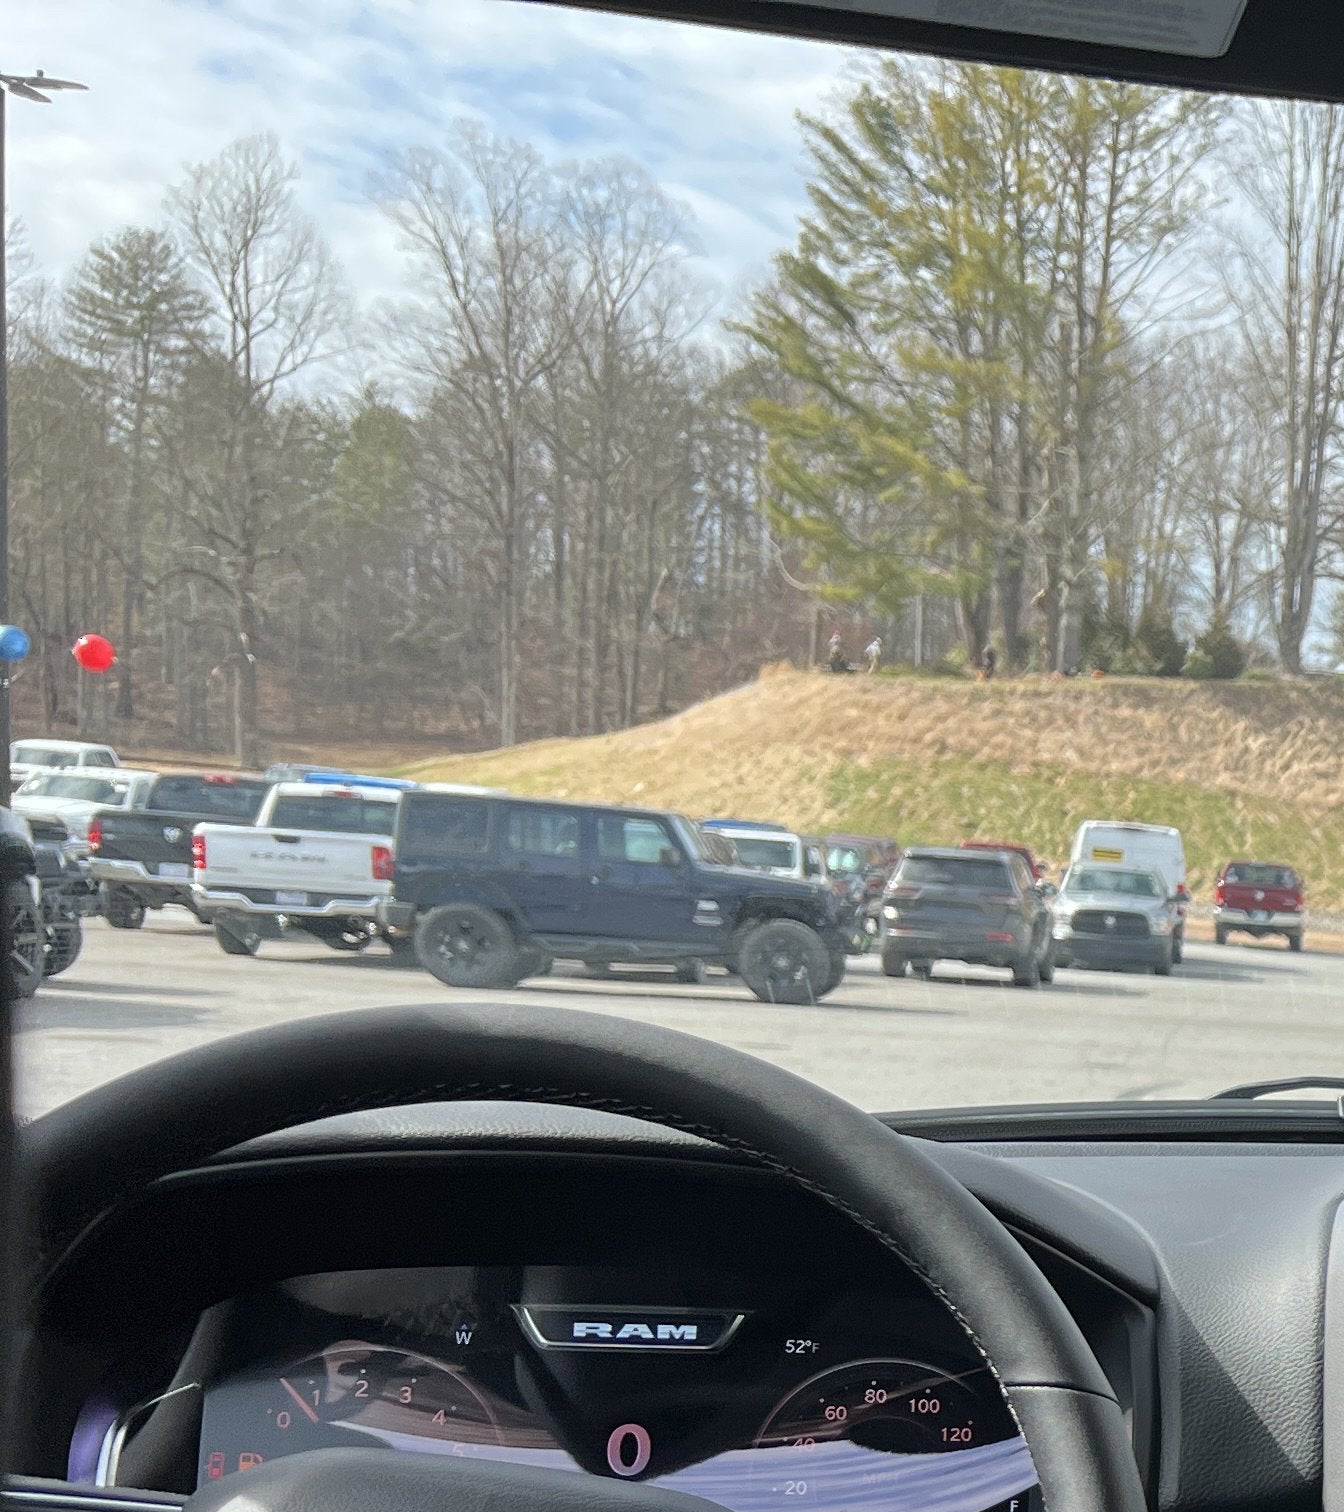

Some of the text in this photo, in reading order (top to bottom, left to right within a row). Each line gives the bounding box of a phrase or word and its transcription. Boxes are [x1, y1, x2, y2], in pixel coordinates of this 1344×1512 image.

[455, 1331, 472, 1345] W
[573, 1321, 698, 1340] RAM
[355, 1380, 369, 1397] 2
[400, 1387, 412, 1404] 3
[312, 1389, 320, 1406] 1
[864, 1389, 887, 1404] 80
[825, 1406, 847, 1421] 60
[909, 1399, 940, 1414] 100
[277, 1412, 290, 1428] 0
[432, 1409, 446, 1425] 4
[941, 1428, 972, 1442] 120
[607, 1423, 651, 1476] 0
[785, 1481, 807, 1495] 20
[1010, 1501, 1019, 1512] F
